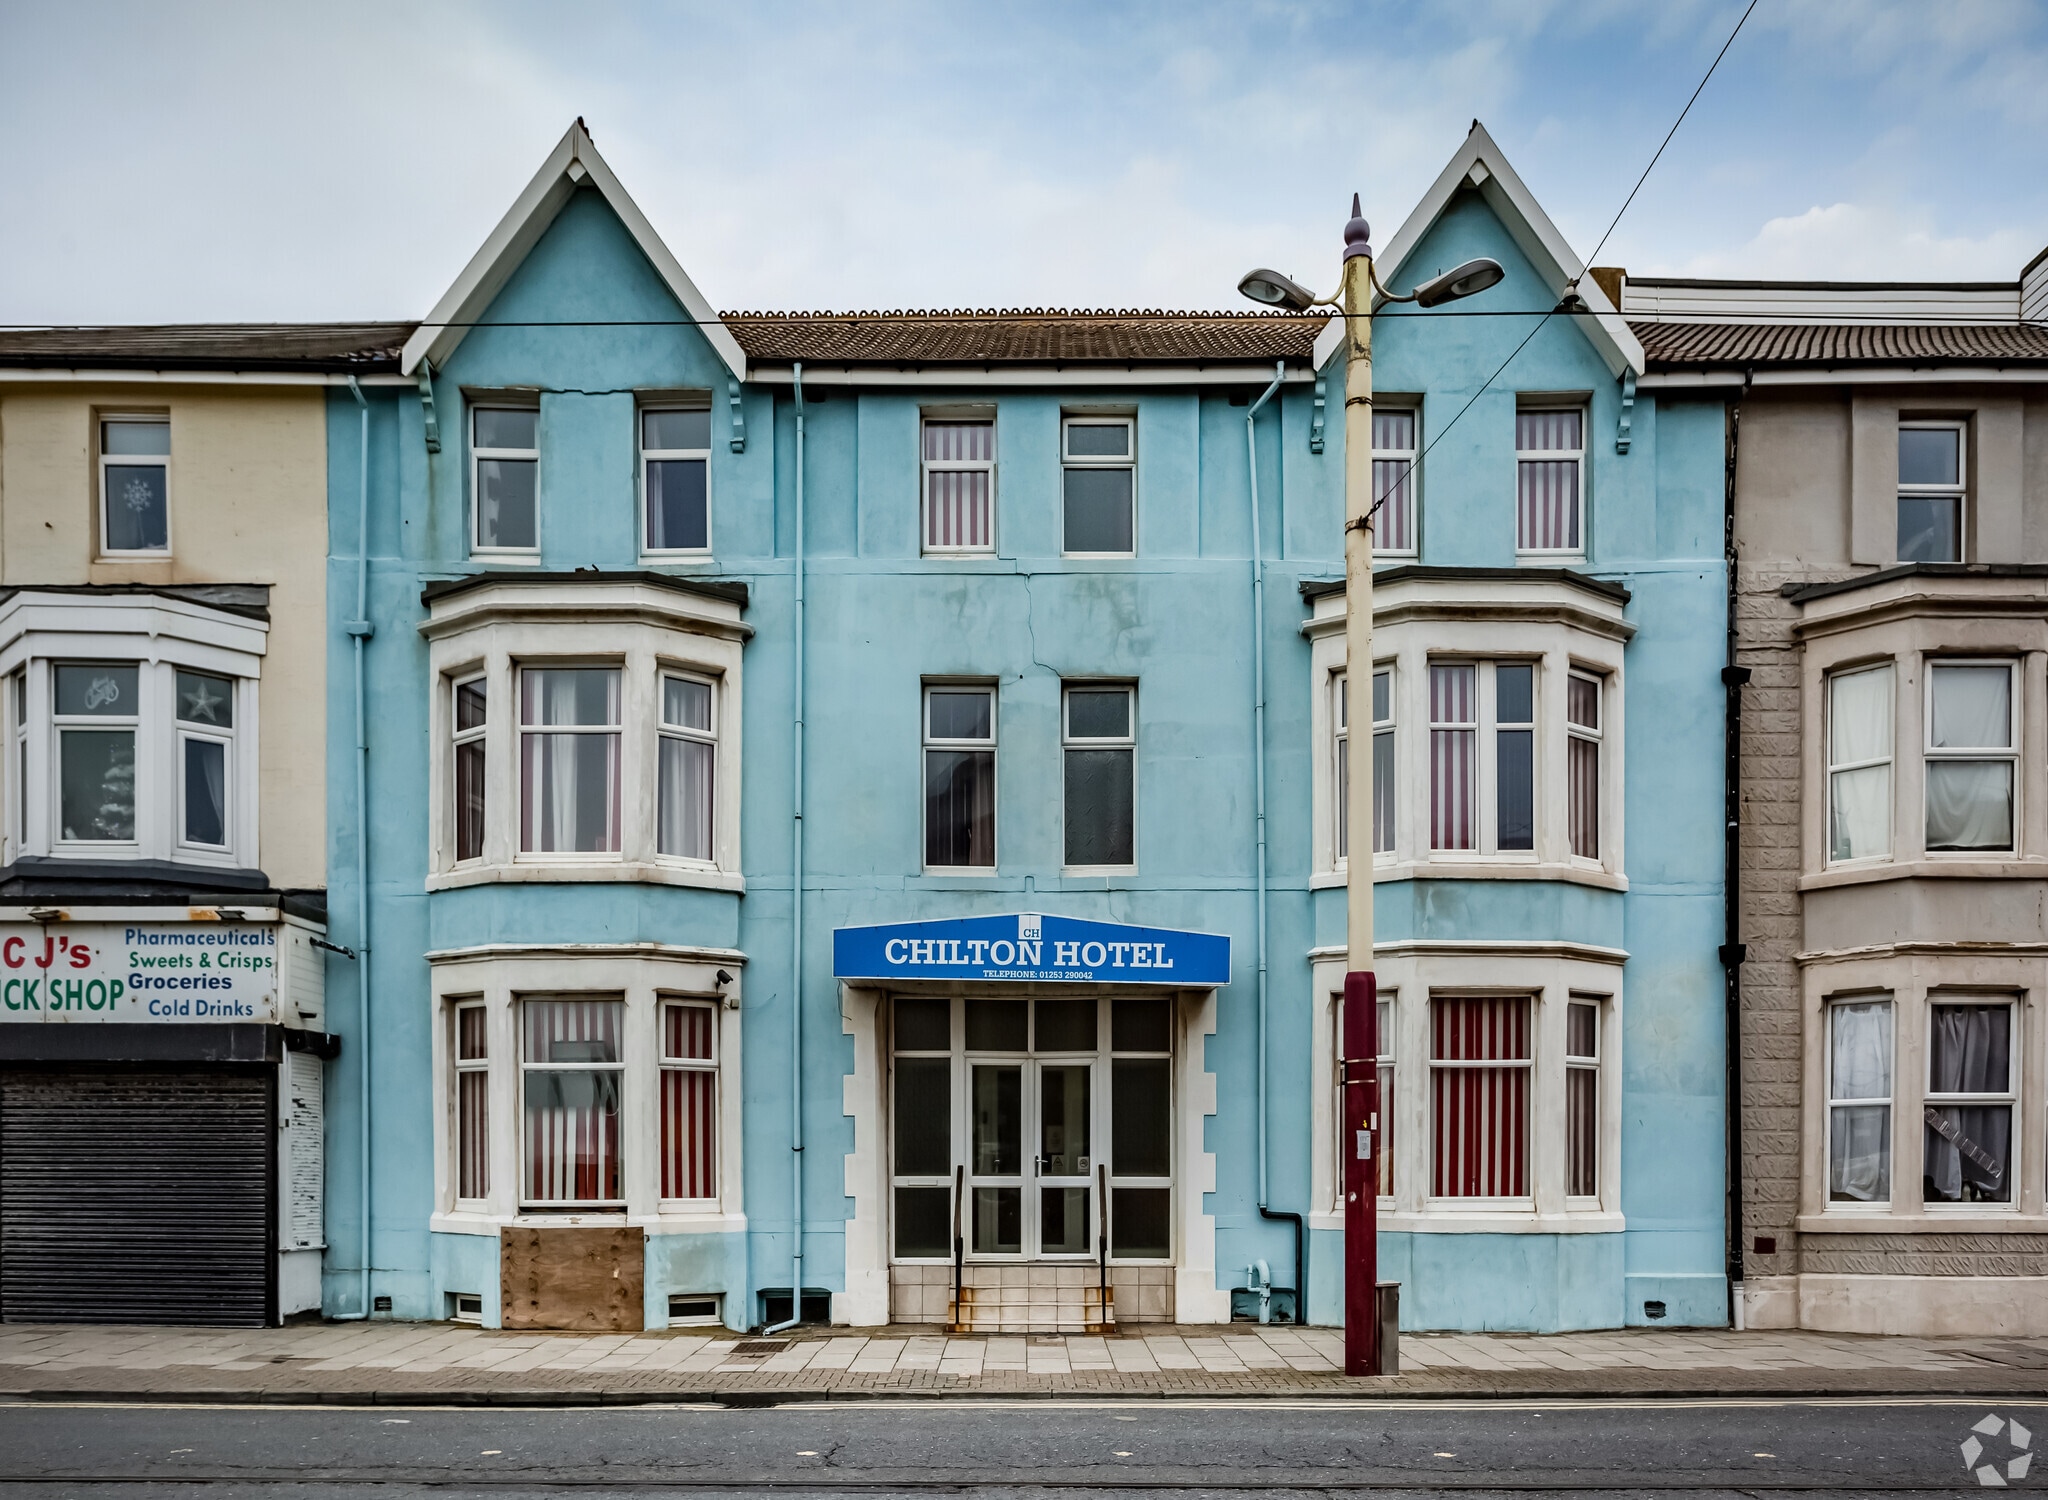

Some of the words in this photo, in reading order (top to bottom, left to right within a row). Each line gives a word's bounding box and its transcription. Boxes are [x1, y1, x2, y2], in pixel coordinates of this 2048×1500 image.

[125, 928, 275, 946] Pharmaceuticals
[1023, 928, 1040, 938] CH
[129, 951, 193, 968] Sweets
[199, 952, 212, 968] &
[217, 951, 273, 973] Crisps
[884, 938, 1044, 966] CHILTON
[1053, 941, 1174, 969] HOTEL
[128, 973, 232, 990] Groceries
[983, 969, 1038, 979] TELEPHONE:
[1039, 971, 1063, 979] 01253
[1064, 971, 1093, 980] 290042
[0, 978, 41, 1011] CK
[50, 978, 125, 1011] SHOP
[148, 999, 190, 1016] Cold
[195, 999, 254, 1016] Drinks
